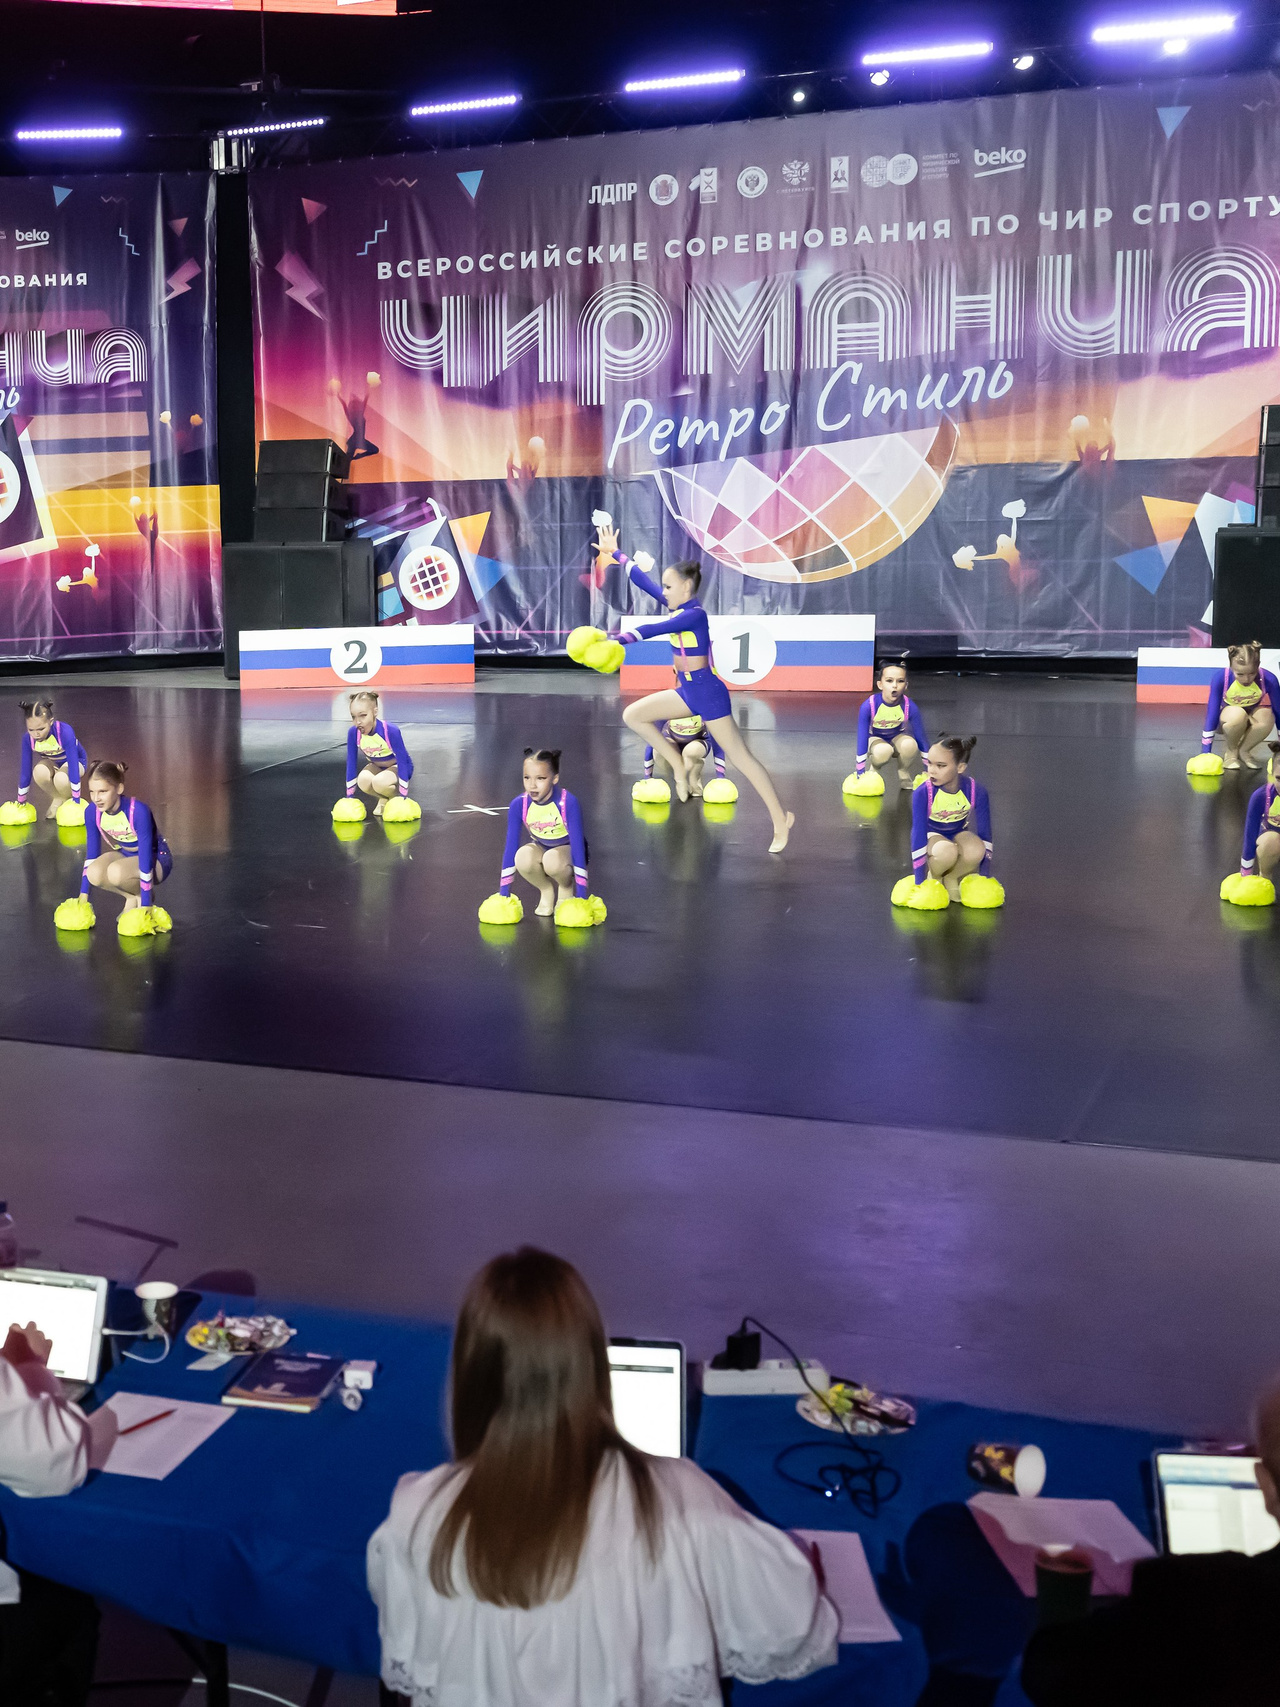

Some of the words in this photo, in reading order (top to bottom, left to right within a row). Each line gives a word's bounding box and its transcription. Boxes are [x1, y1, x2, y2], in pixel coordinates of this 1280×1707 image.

[974, 146, 1027, 166] beko
[588, 182, 638, 207] ЛДПР
[15, 228, 50, 242] beko
[377, 242, 648, 280] ВСЕРОССИЙСКИЕ
[664, 218, 951, 258] СОРЕВНОВАНИЯ
[970, 214, 1020, 237] ПО
[1038, 208, 1114, 231] ЧИР
[608, 397, 792, 470] Ретро
[816, 360, 1016, 433] Стиль
[343, 639, 368, 674] 2
[730, 631, 756, 674] 1
